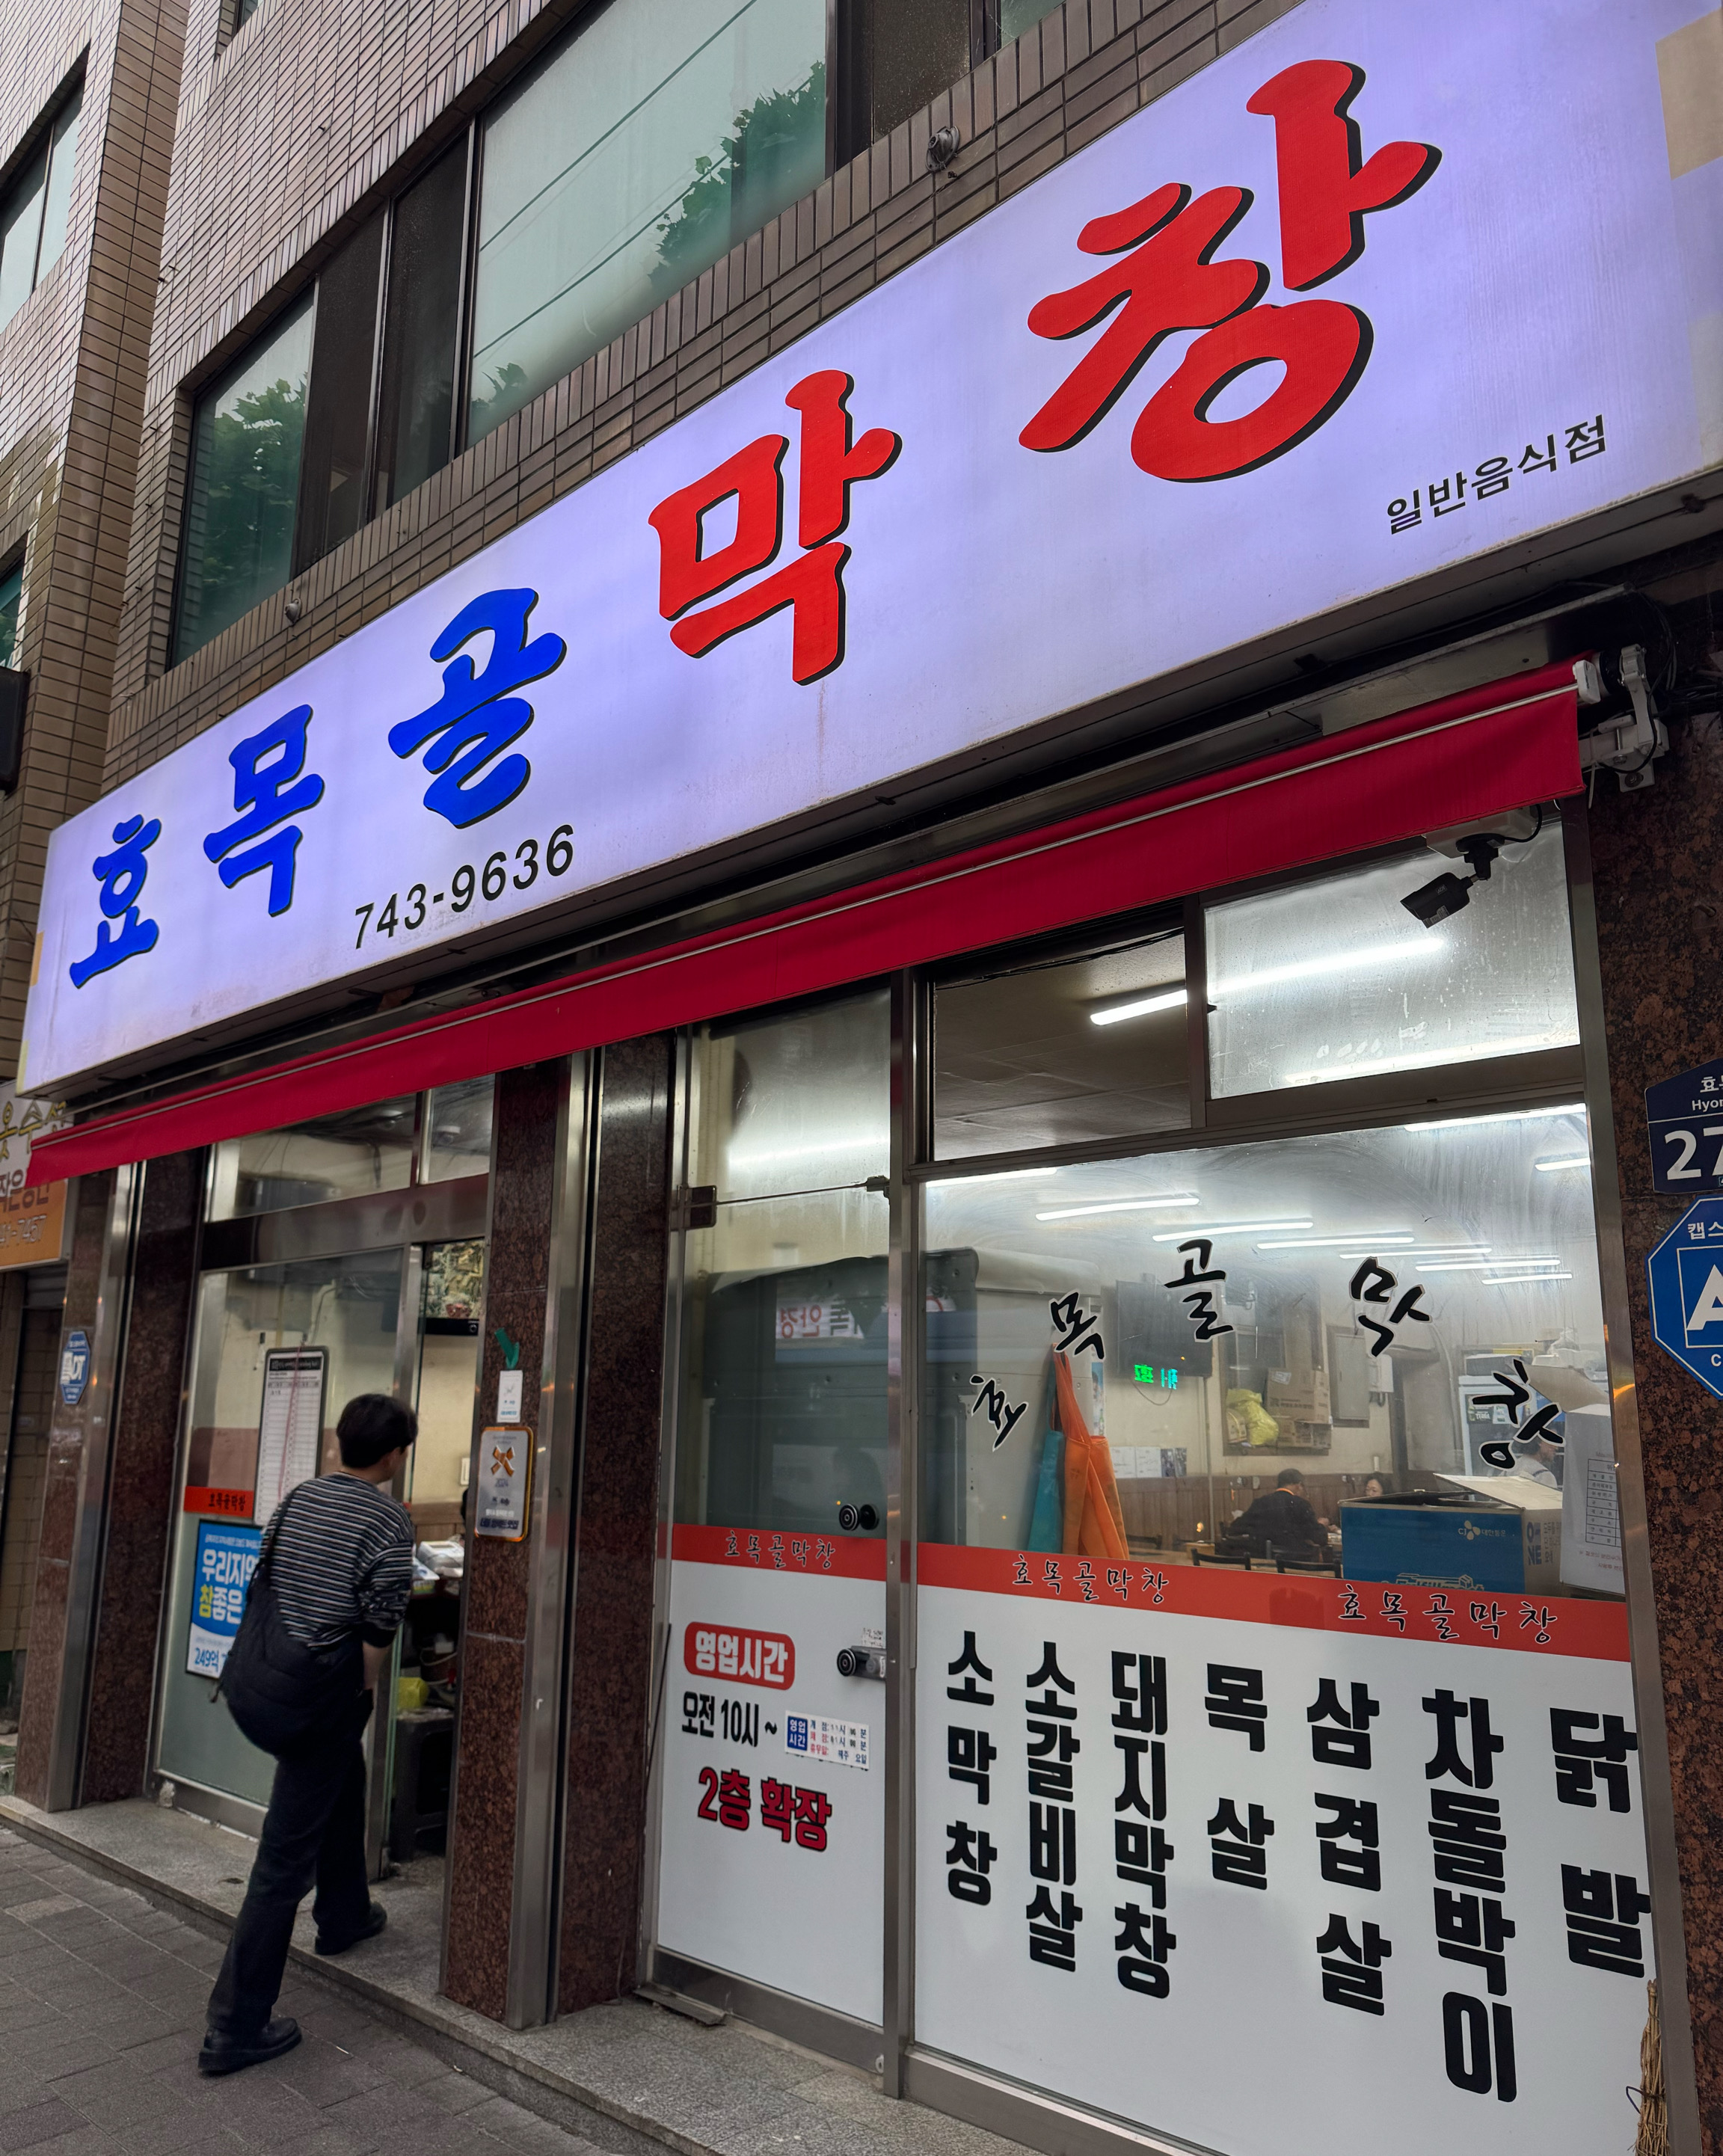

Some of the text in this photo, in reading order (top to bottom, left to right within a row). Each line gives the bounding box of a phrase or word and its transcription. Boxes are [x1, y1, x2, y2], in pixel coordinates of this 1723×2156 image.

[1386, 414, 1606, 535] 일반음식점
[354, 824, 575, 950] 743-9636
[1692, 1099, 1723, 1113] Hyo
[1699, 1075, 1723, 1093] 효
[695, 1630, 789, 1683] 영업시간
[681, 1691, 715, 1735] 오전
[789, 1733, 806, 1748] 시간
[790, 1719, 806, 1733] 영업
[698, 1766, 832, 1852] 2층 확장
[946, 1630, 998, 1906] 소막창
[1025, 1641, 1083, 1973] 소갈비살
[1111, 1650, 1177, 1999] 돼지막창
[1306, 1677, 1392, 2016] 삼겹살
[1422, 1689, 1517, 2103] 차돌박이
